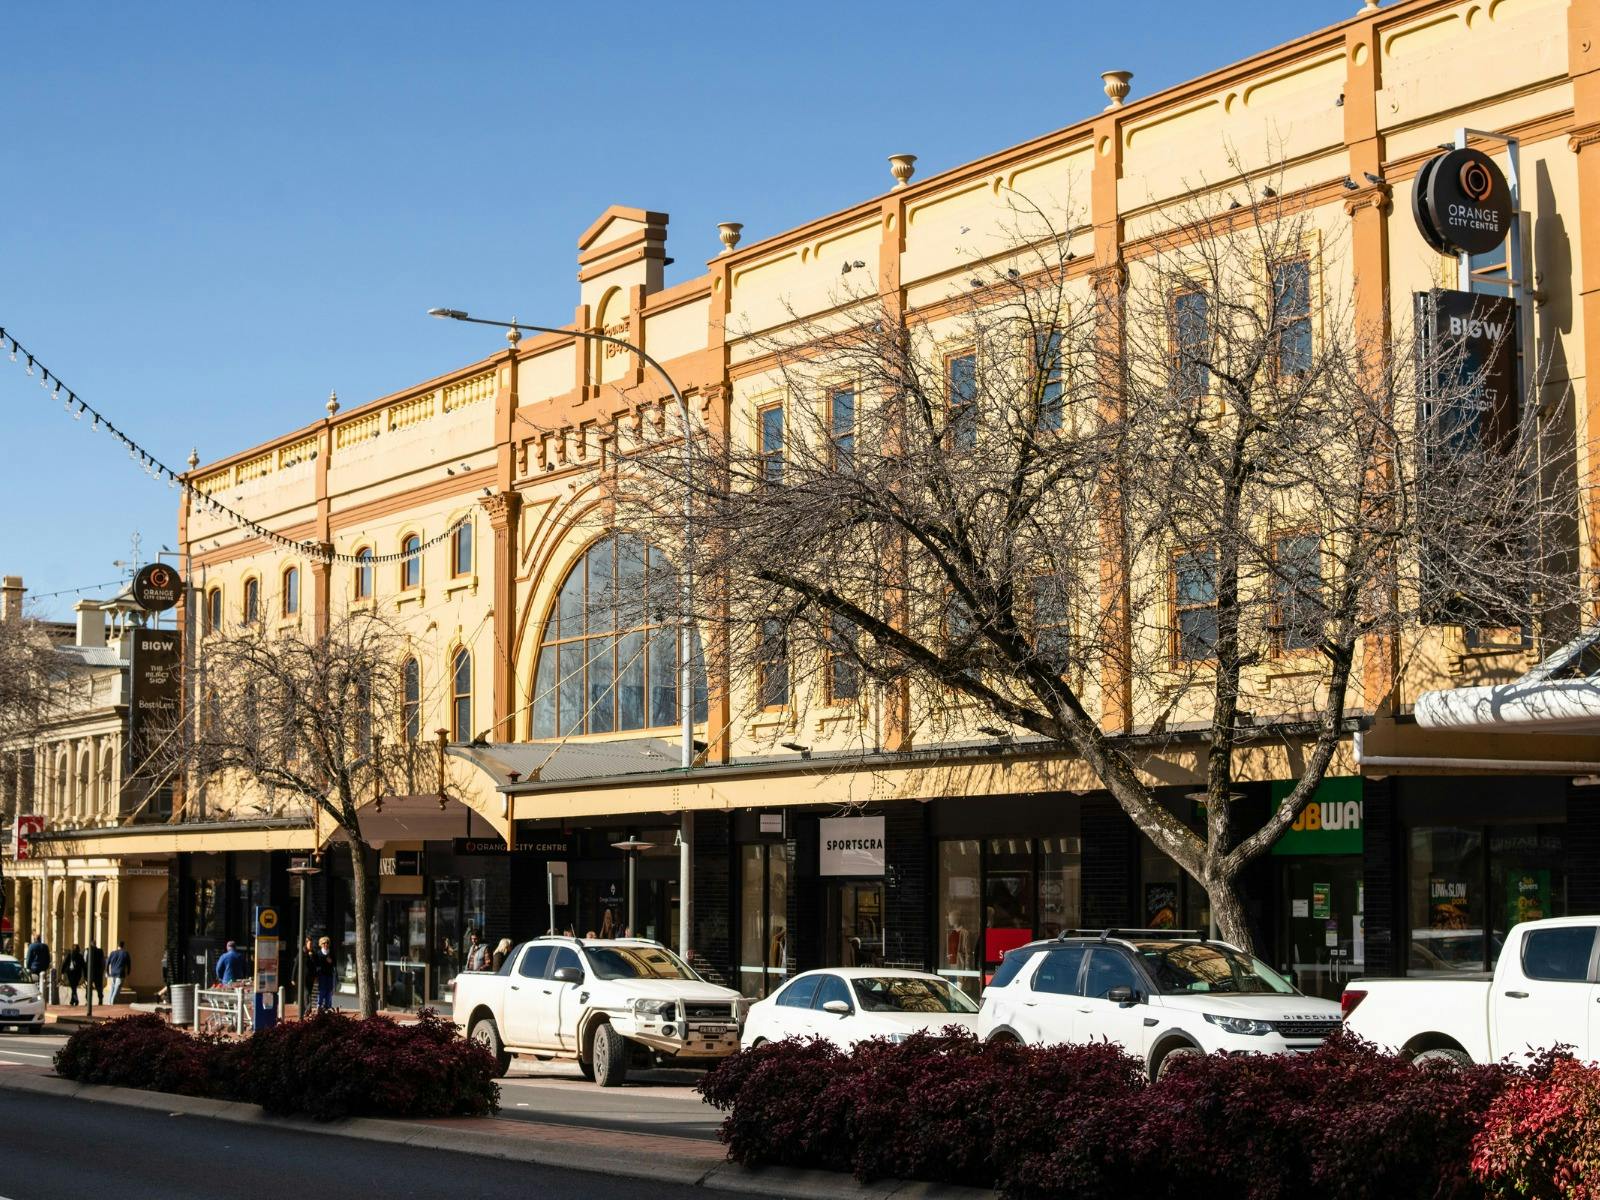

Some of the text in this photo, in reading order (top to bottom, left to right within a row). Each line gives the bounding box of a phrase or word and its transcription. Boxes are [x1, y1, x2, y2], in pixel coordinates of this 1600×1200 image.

[1448, 204, 1499, 224] ORANGE
[1448, 217, 1499, 232] CITY CENTRE
[604, 321, 630, 338] FOUNDE
[143, 589, 174, 597] ORANGE
[1291, 800, 1363, 832] UBWA
[476, 843, 568, 852] ORANG CITY CENTRE
[827, 838, 883, 851] SPORTSCRA
[1448, 883, 1467, 898] SLOW
[1452, 898, 1468, 907] pork
